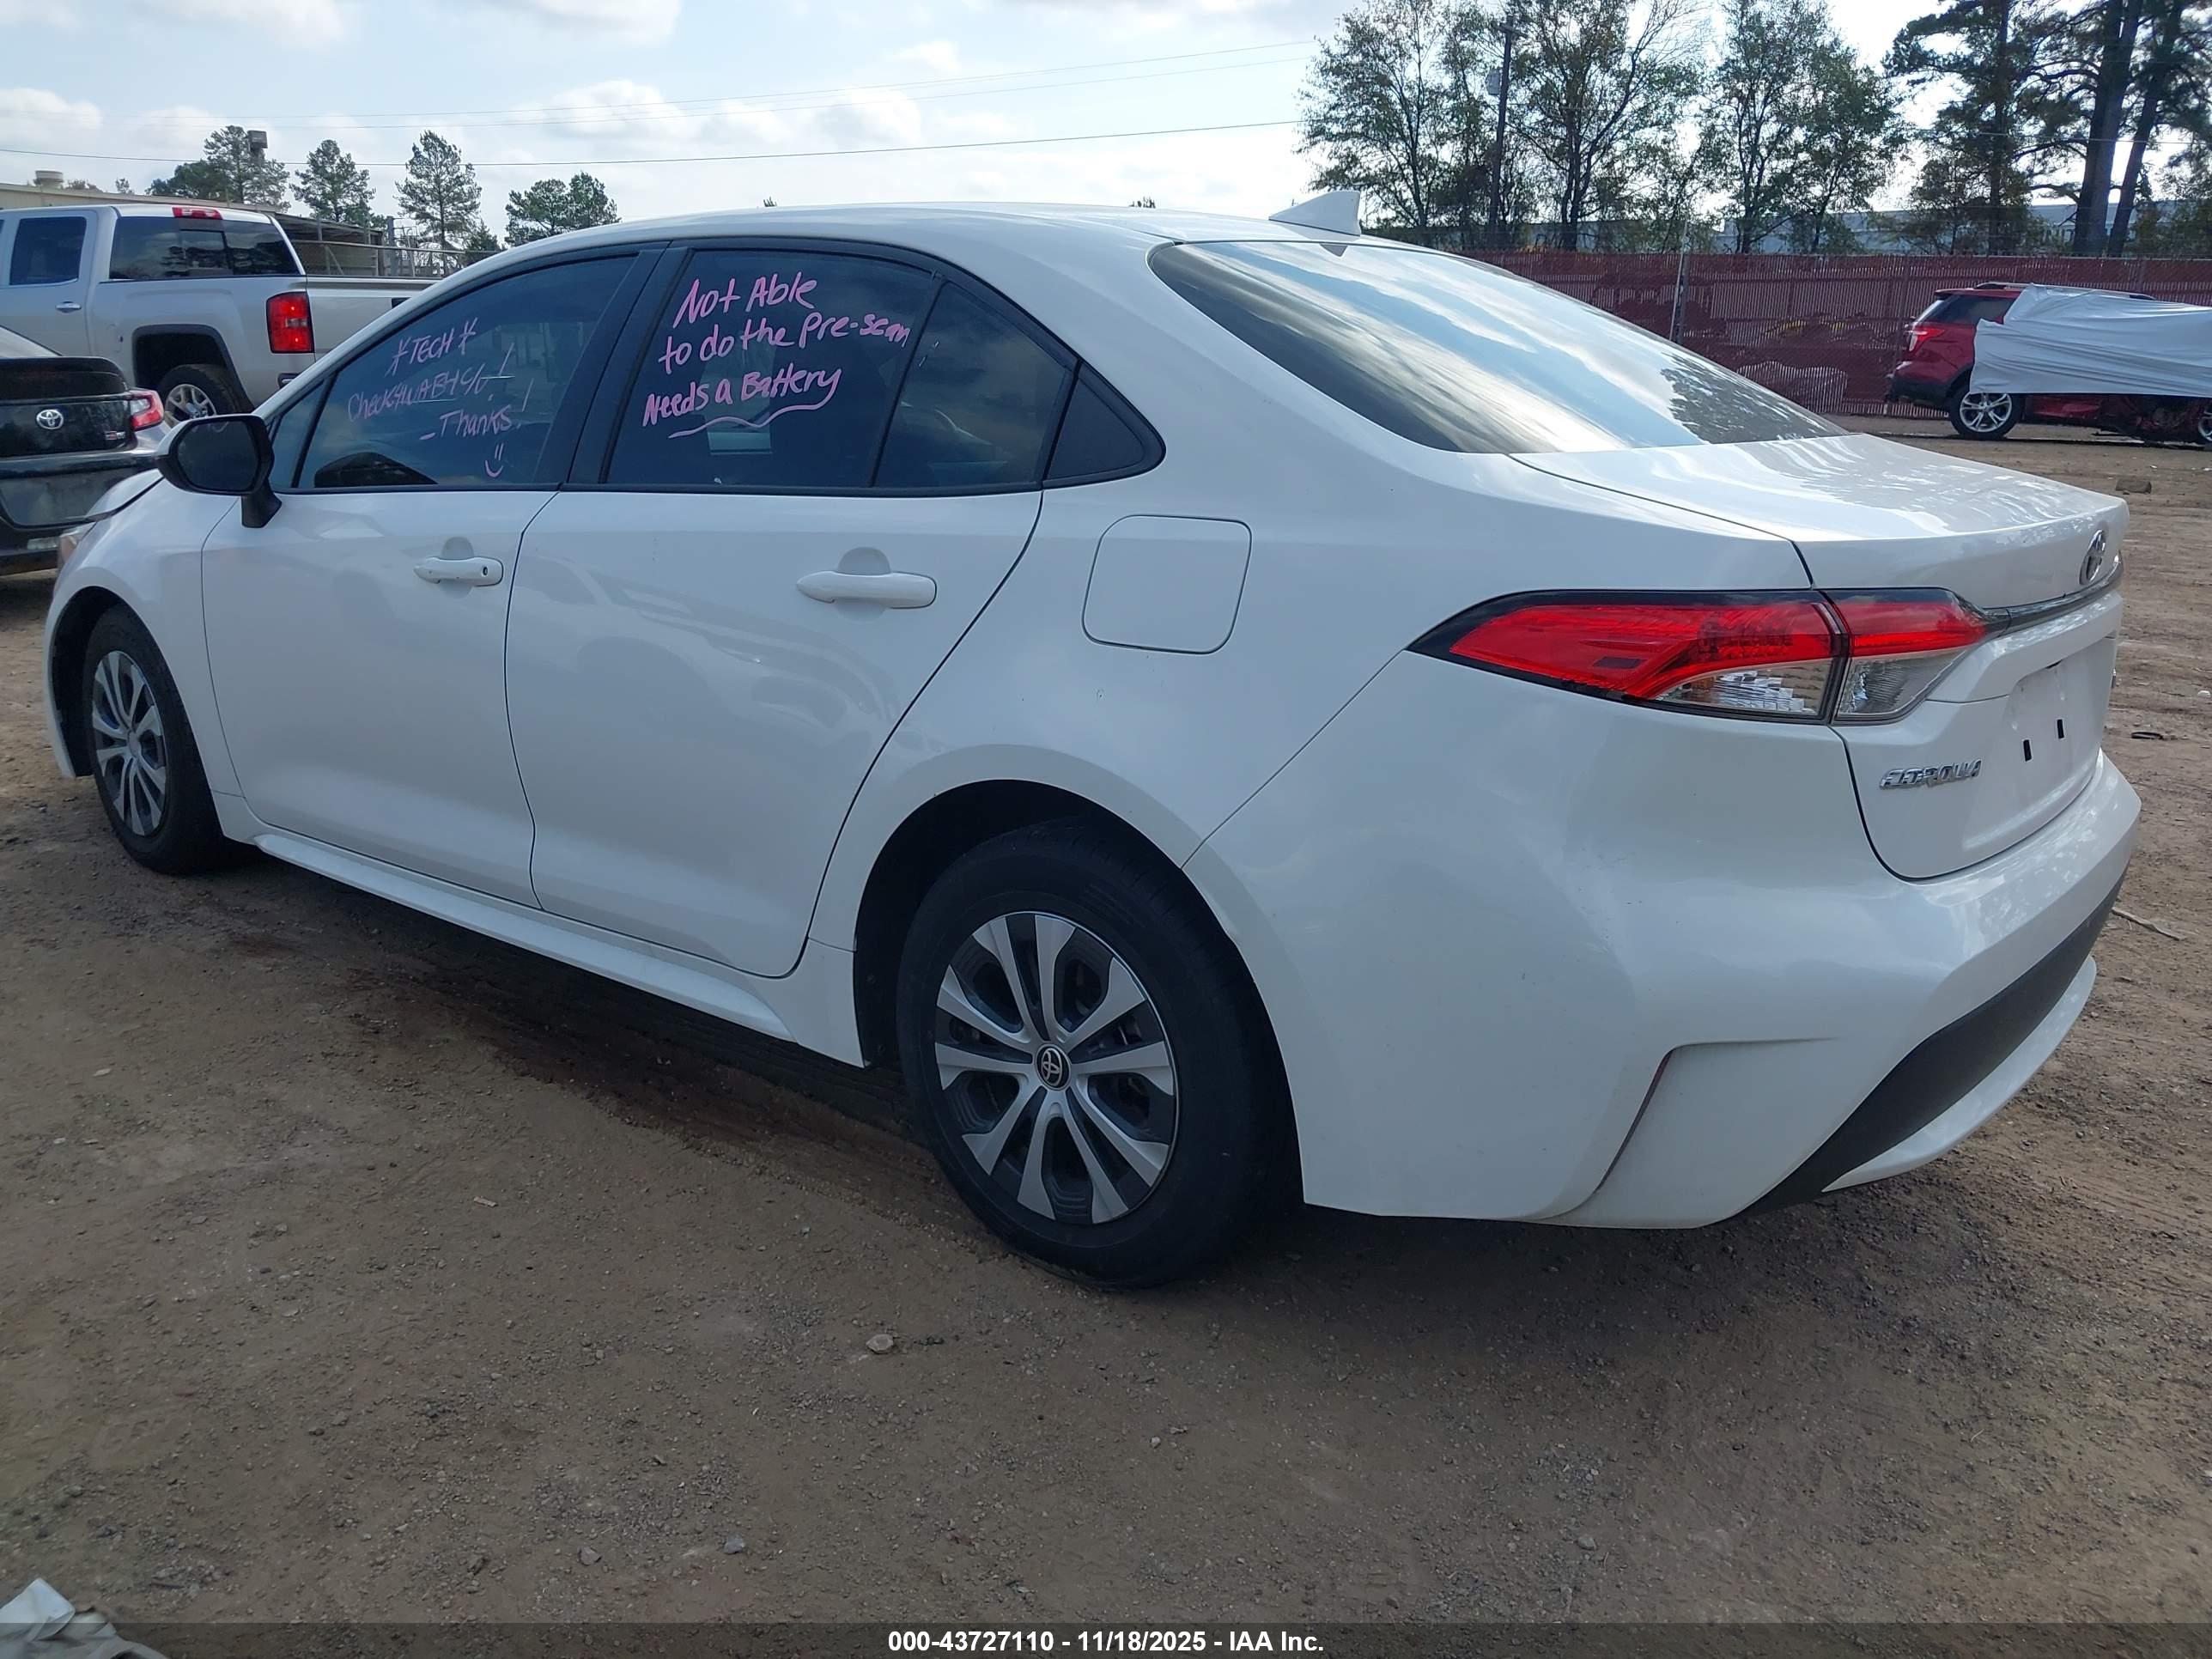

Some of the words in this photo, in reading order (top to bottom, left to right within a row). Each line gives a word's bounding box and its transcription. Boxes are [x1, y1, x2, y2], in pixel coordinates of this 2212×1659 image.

[673, 278, 741, 329] Not
[745, 271, 817, 312] Able
[658, 336, 692, 374] to
[699, 324, 735, 362] do
[740, 317, 795, 351] the
[642, 381, 709, 427] Needs
[740, 362, 842, 410] Battery
